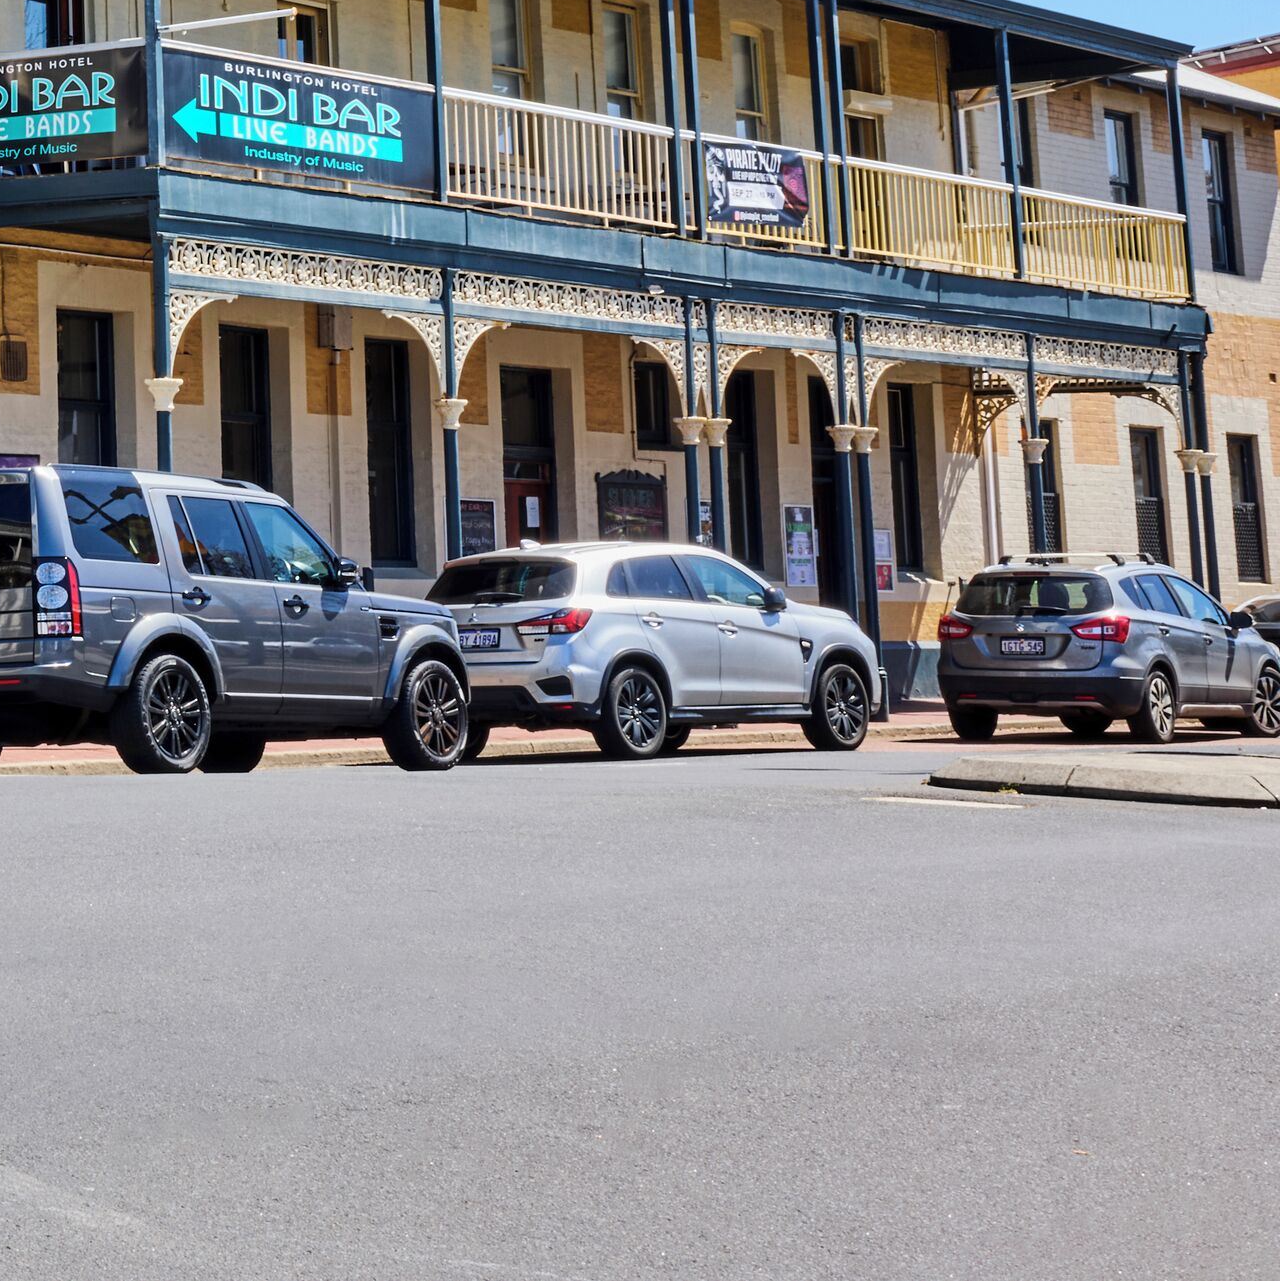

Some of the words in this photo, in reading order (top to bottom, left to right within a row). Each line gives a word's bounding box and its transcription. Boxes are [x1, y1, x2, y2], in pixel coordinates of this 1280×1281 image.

[49, 57, 94, 70] HOTEL
[32, 72, 116, 112] BAR
[224, 62, 324, 88] BURLINGTON
[331, 80, 379, 97] HOTEL
[200, 73, 298, 121] INDI
[313, 92, 402, 138] BAR
[25, 111, 93, 137] BANDS
[232, 116, 288, 145] LIVE
[306, 127, 379, 158] BANDS
[24, 146, 37, 156] of
[40, 142, 78, 155] Music
[244, 145, 302, 166] Industry
[305, 155, 321, 167] of
[323, 157, 364, 173] Music
[725, 148, 757, 170] PIRATE
